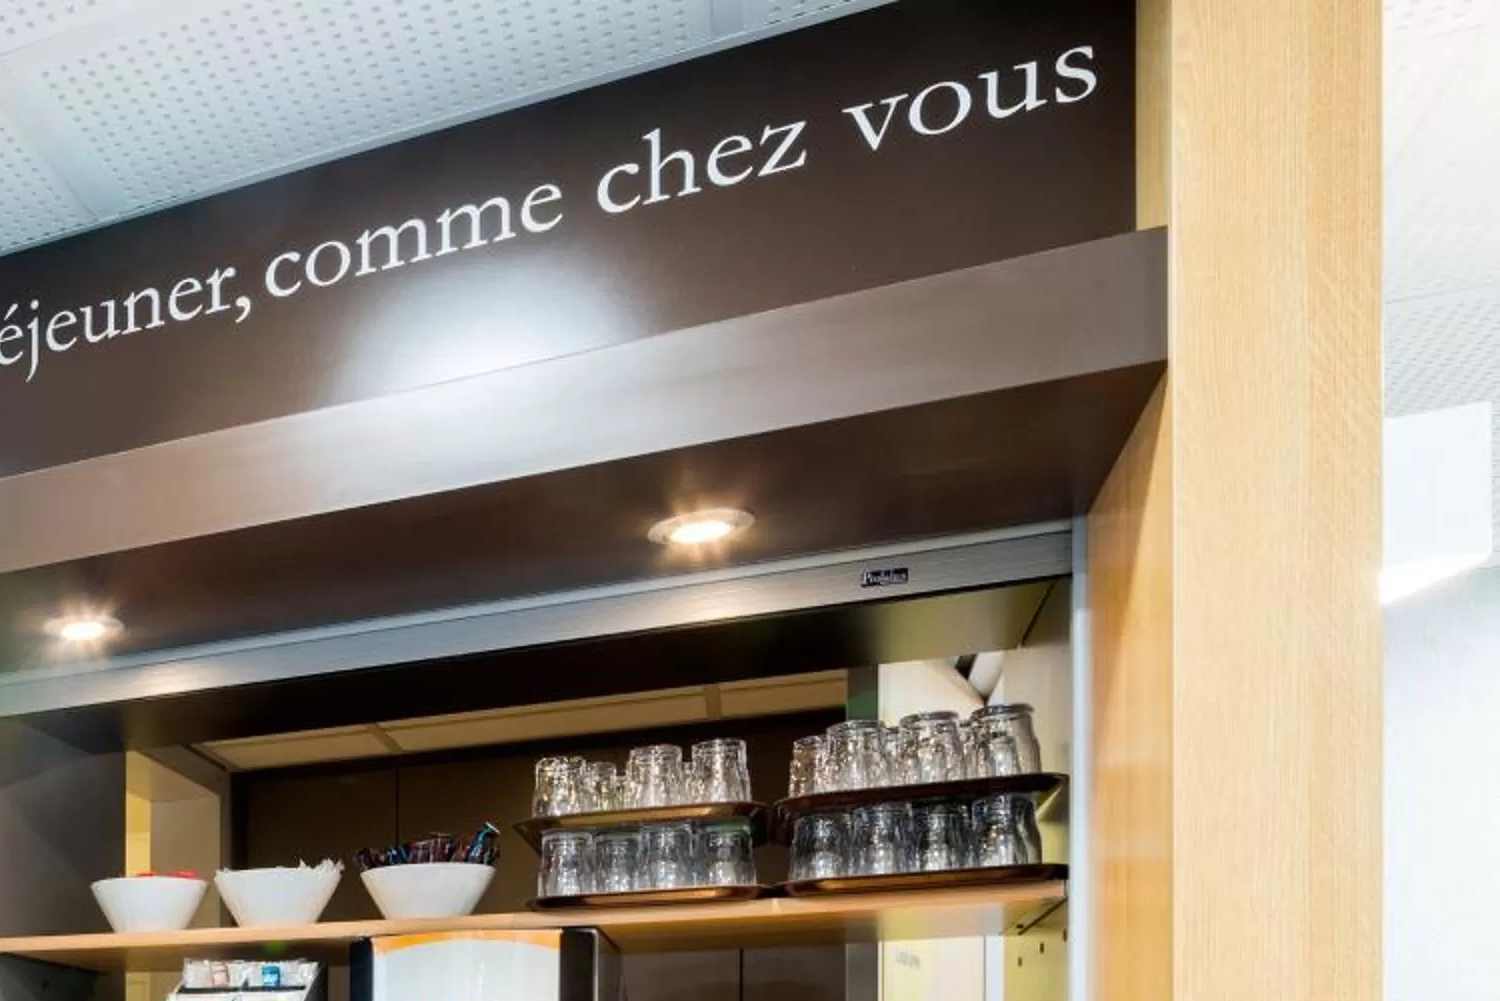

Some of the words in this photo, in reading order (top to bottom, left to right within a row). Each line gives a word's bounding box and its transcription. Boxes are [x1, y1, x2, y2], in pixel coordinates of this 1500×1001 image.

[263, 182, 564, 298] comme
[595, 119, 808, 215] chez
[841, 44, 1098, 152] vous
